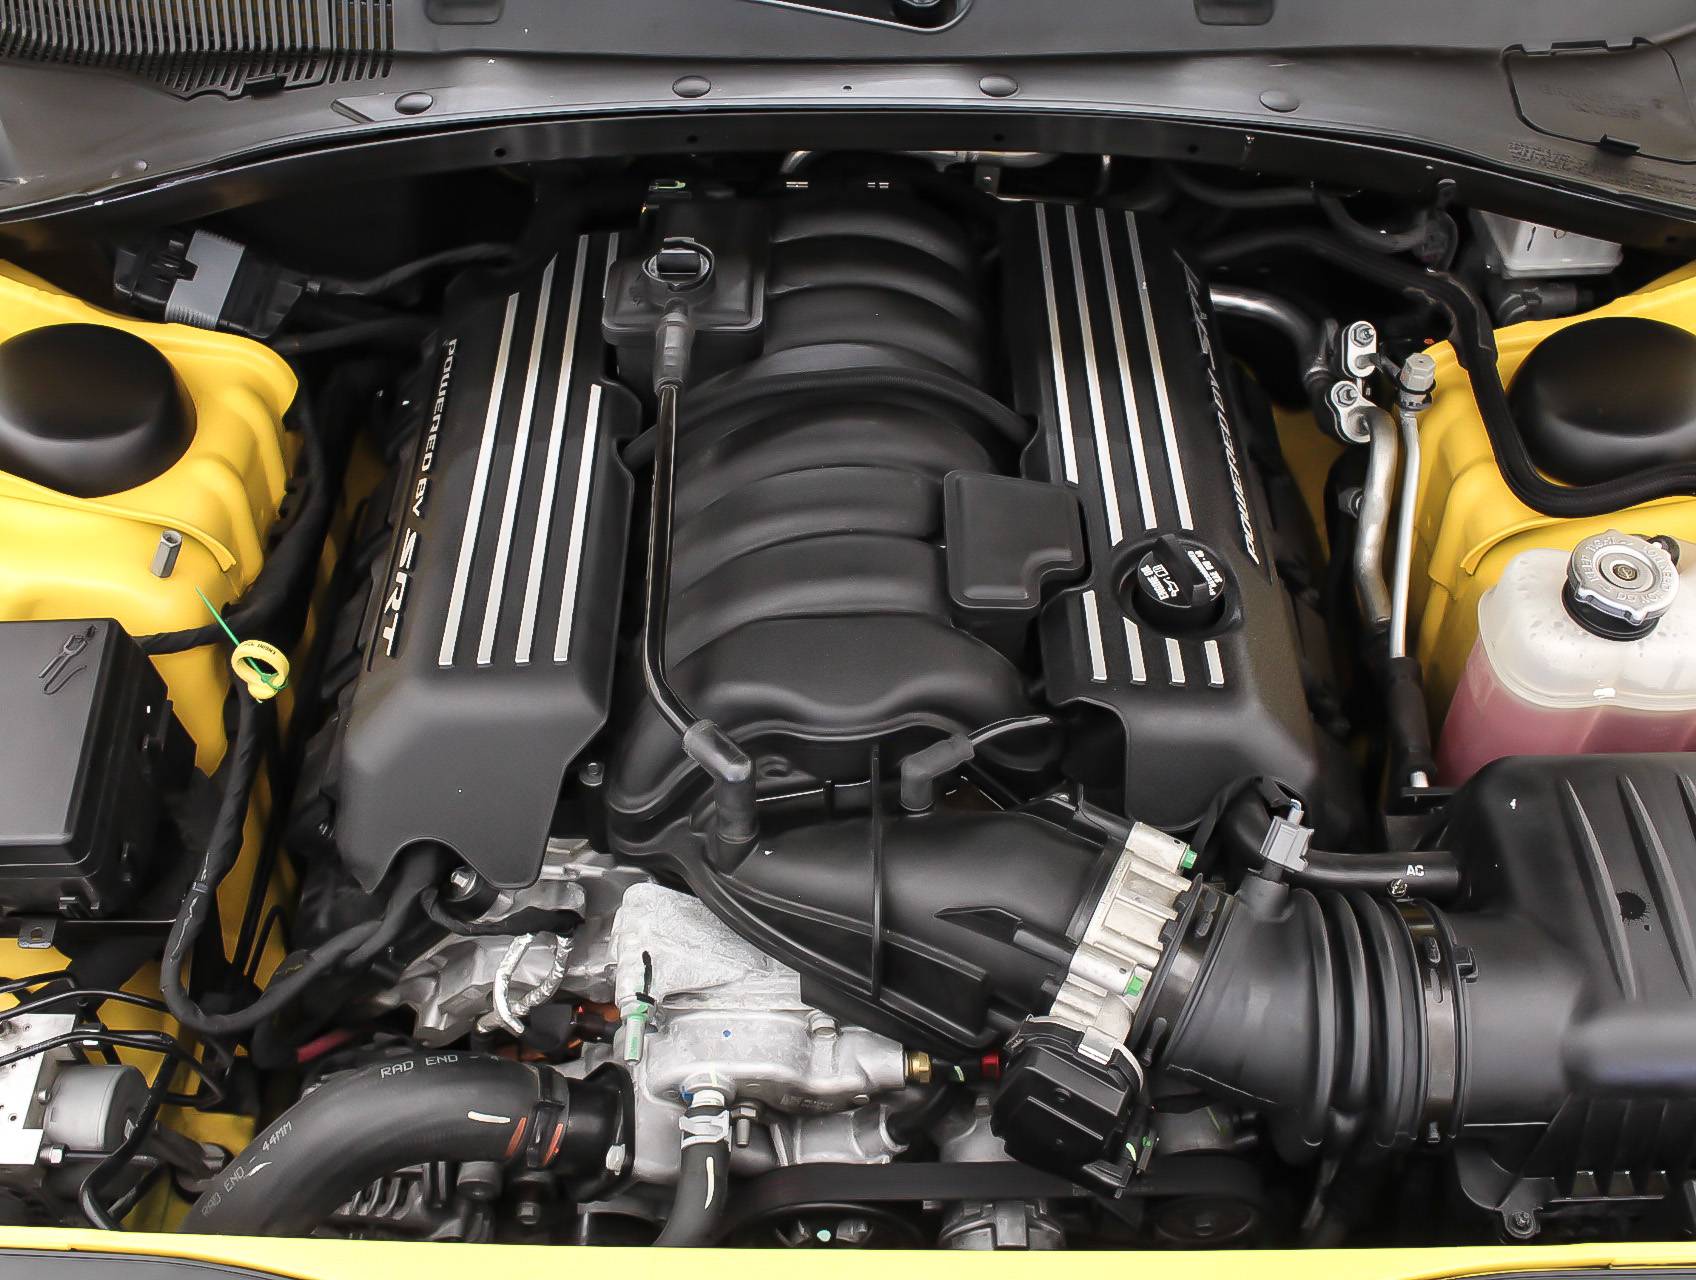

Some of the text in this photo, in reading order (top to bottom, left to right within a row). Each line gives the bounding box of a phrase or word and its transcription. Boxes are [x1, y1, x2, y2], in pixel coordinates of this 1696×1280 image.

[382, 338, 458, 657] POWERED BY SRT
[1218, 410, 1260, 565] POWERED
[1147, 574, 1170, 601] ENGINE
[1406, 864, 1425, 877] AC
[381, 1054, 458, 1079] RAD END
[223, 1166, 245, 1193] END
[262, 1120, 293, 1152] 44MM
